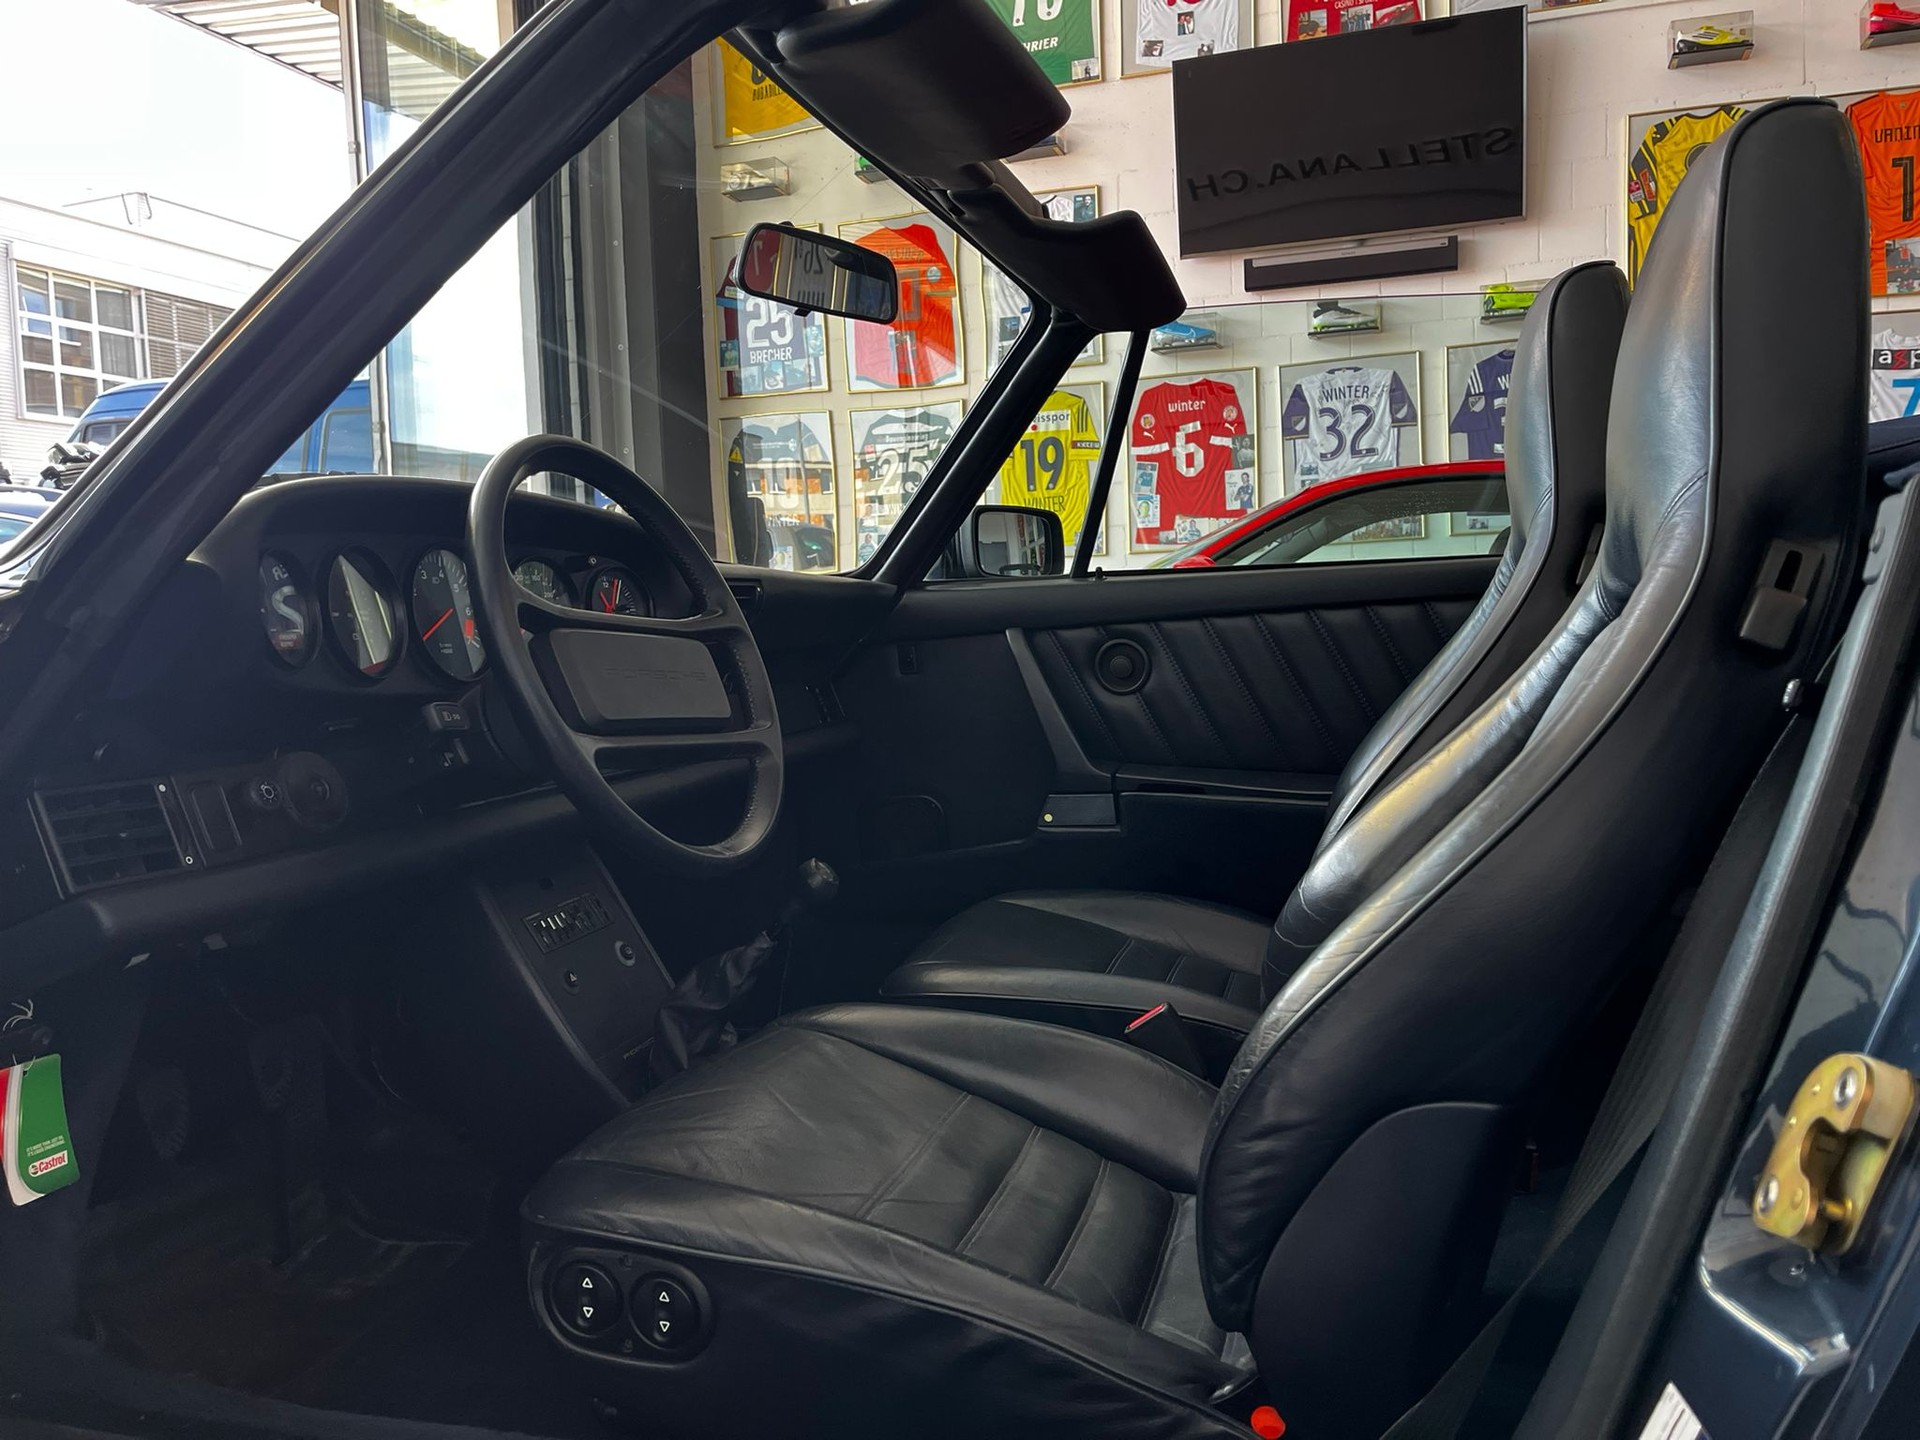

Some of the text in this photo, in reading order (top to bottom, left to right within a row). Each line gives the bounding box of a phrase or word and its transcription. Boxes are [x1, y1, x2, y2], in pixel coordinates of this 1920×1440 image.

[746, 295, 794, 348] 25
[750, 347, 792, 364] BRECHER
[1321, 384, 1370, 402] WINTER
[1168, 399, 1206, 413] winter
[1318, 403, 1379, 462] 32
[1172, 420, 1204, 477] 6
[1020, 436, 1065, 492] 19
[1023, 495, 1066, 512] WINTER
[38, 1153, 66, 1172] Castrol
